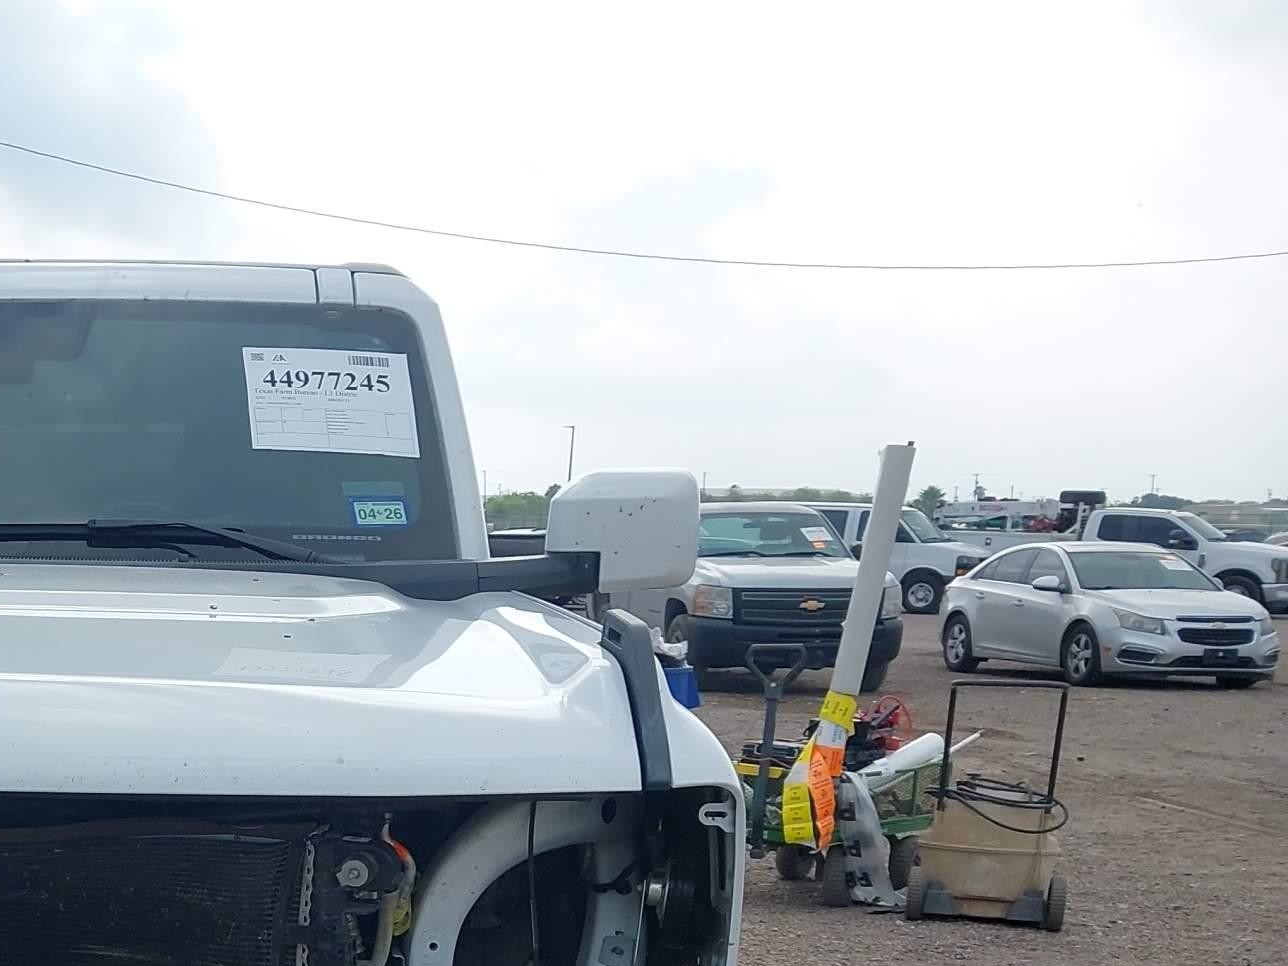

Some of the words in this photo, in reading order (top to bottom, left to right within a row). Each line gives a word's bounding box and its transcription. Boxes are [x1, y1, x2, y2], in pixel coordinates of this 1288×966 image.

[263, 370, 390, 393] 44977245
[255, 387, 274, 395] Texas
[358, 508, 377, 521] 04
[383, 507, 403, 521] 26
